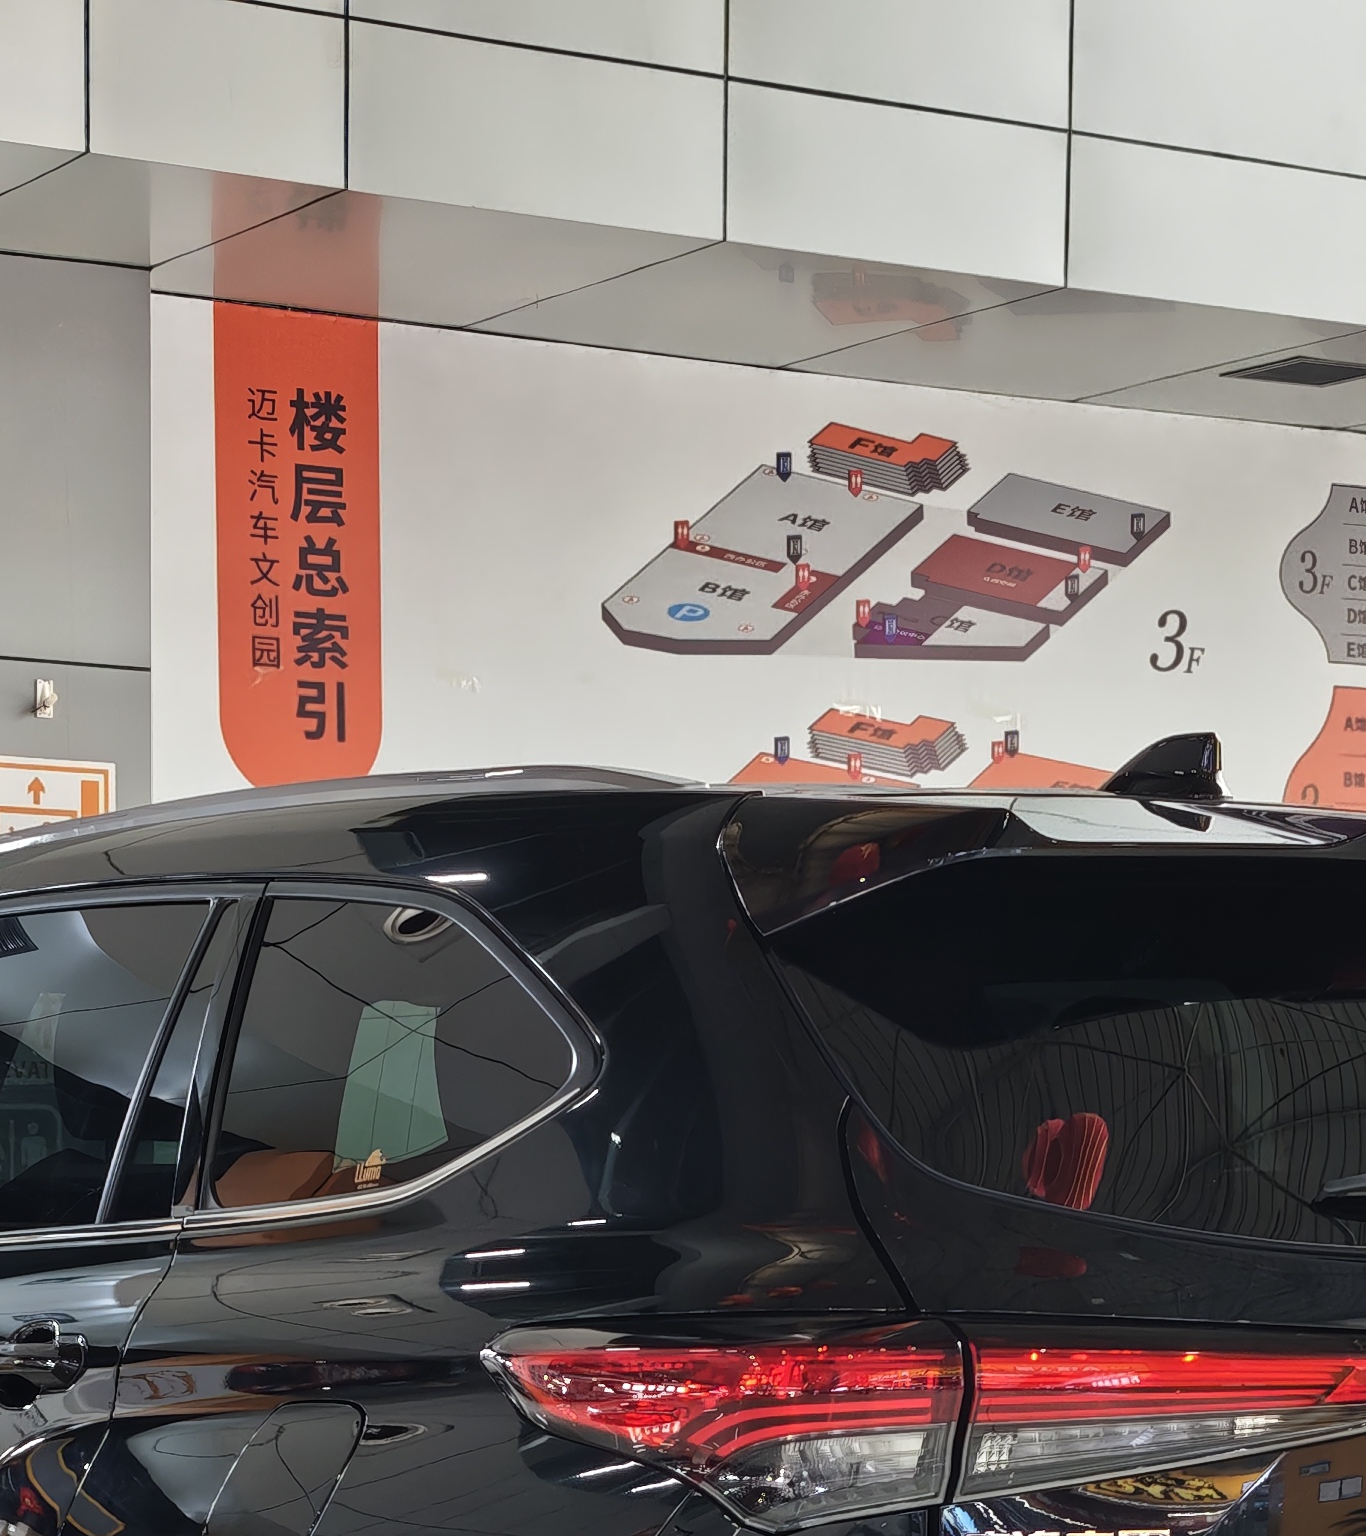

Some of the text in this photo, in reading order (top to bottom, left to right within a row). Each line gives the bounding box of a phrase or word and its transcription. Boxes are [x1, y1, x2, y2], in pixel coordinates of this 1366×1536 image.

[777, 512, 831, 533] A馆
[1051, 502, 1098, 522] E馆
[247, 388, 281, 670] 迈卡汽车文创园
[290, 388, 349, 743] 楼层总索引
[698, 582, 752, 602] B馆
[1148, 610, 1206, 674] 3F
[1343, 772, 1366, 788] B馆
